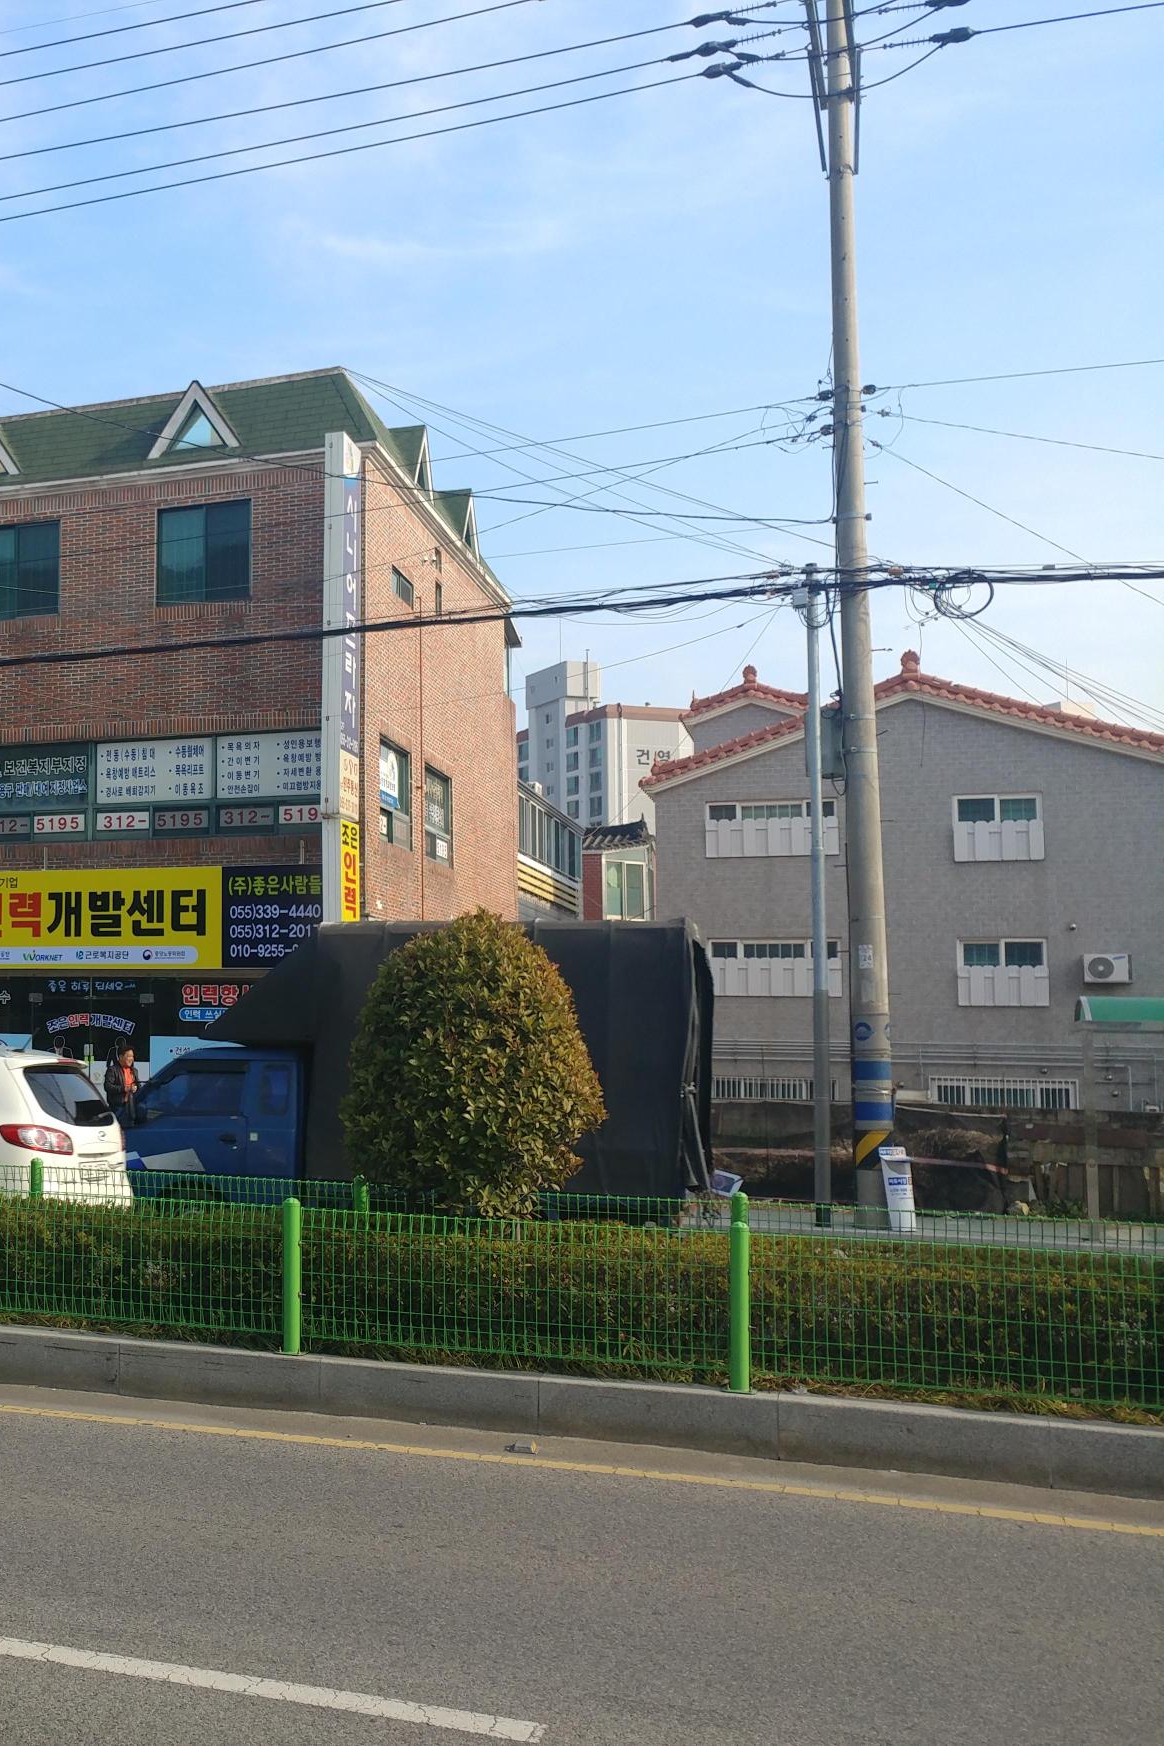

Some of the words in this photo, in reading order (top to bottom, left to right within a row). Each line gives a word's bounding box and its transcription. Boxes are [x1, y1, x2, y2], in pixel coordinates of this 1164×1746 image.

[3, 755, 87, 776] 보건복지부지정
[36, 816, 80, 831] 5195
[103, 814, 147, 829] 312-
[156, 812, 203, 828] 5195
[224, 810, 270, 825] 312-
[228, 875, 323, 897] (주)좋은사람들
[229, 904, 321, 920] 055)339-4440
[84, 950, 129, 960] 근로복지공단
[184, 1009, 201, 1019] 인력
